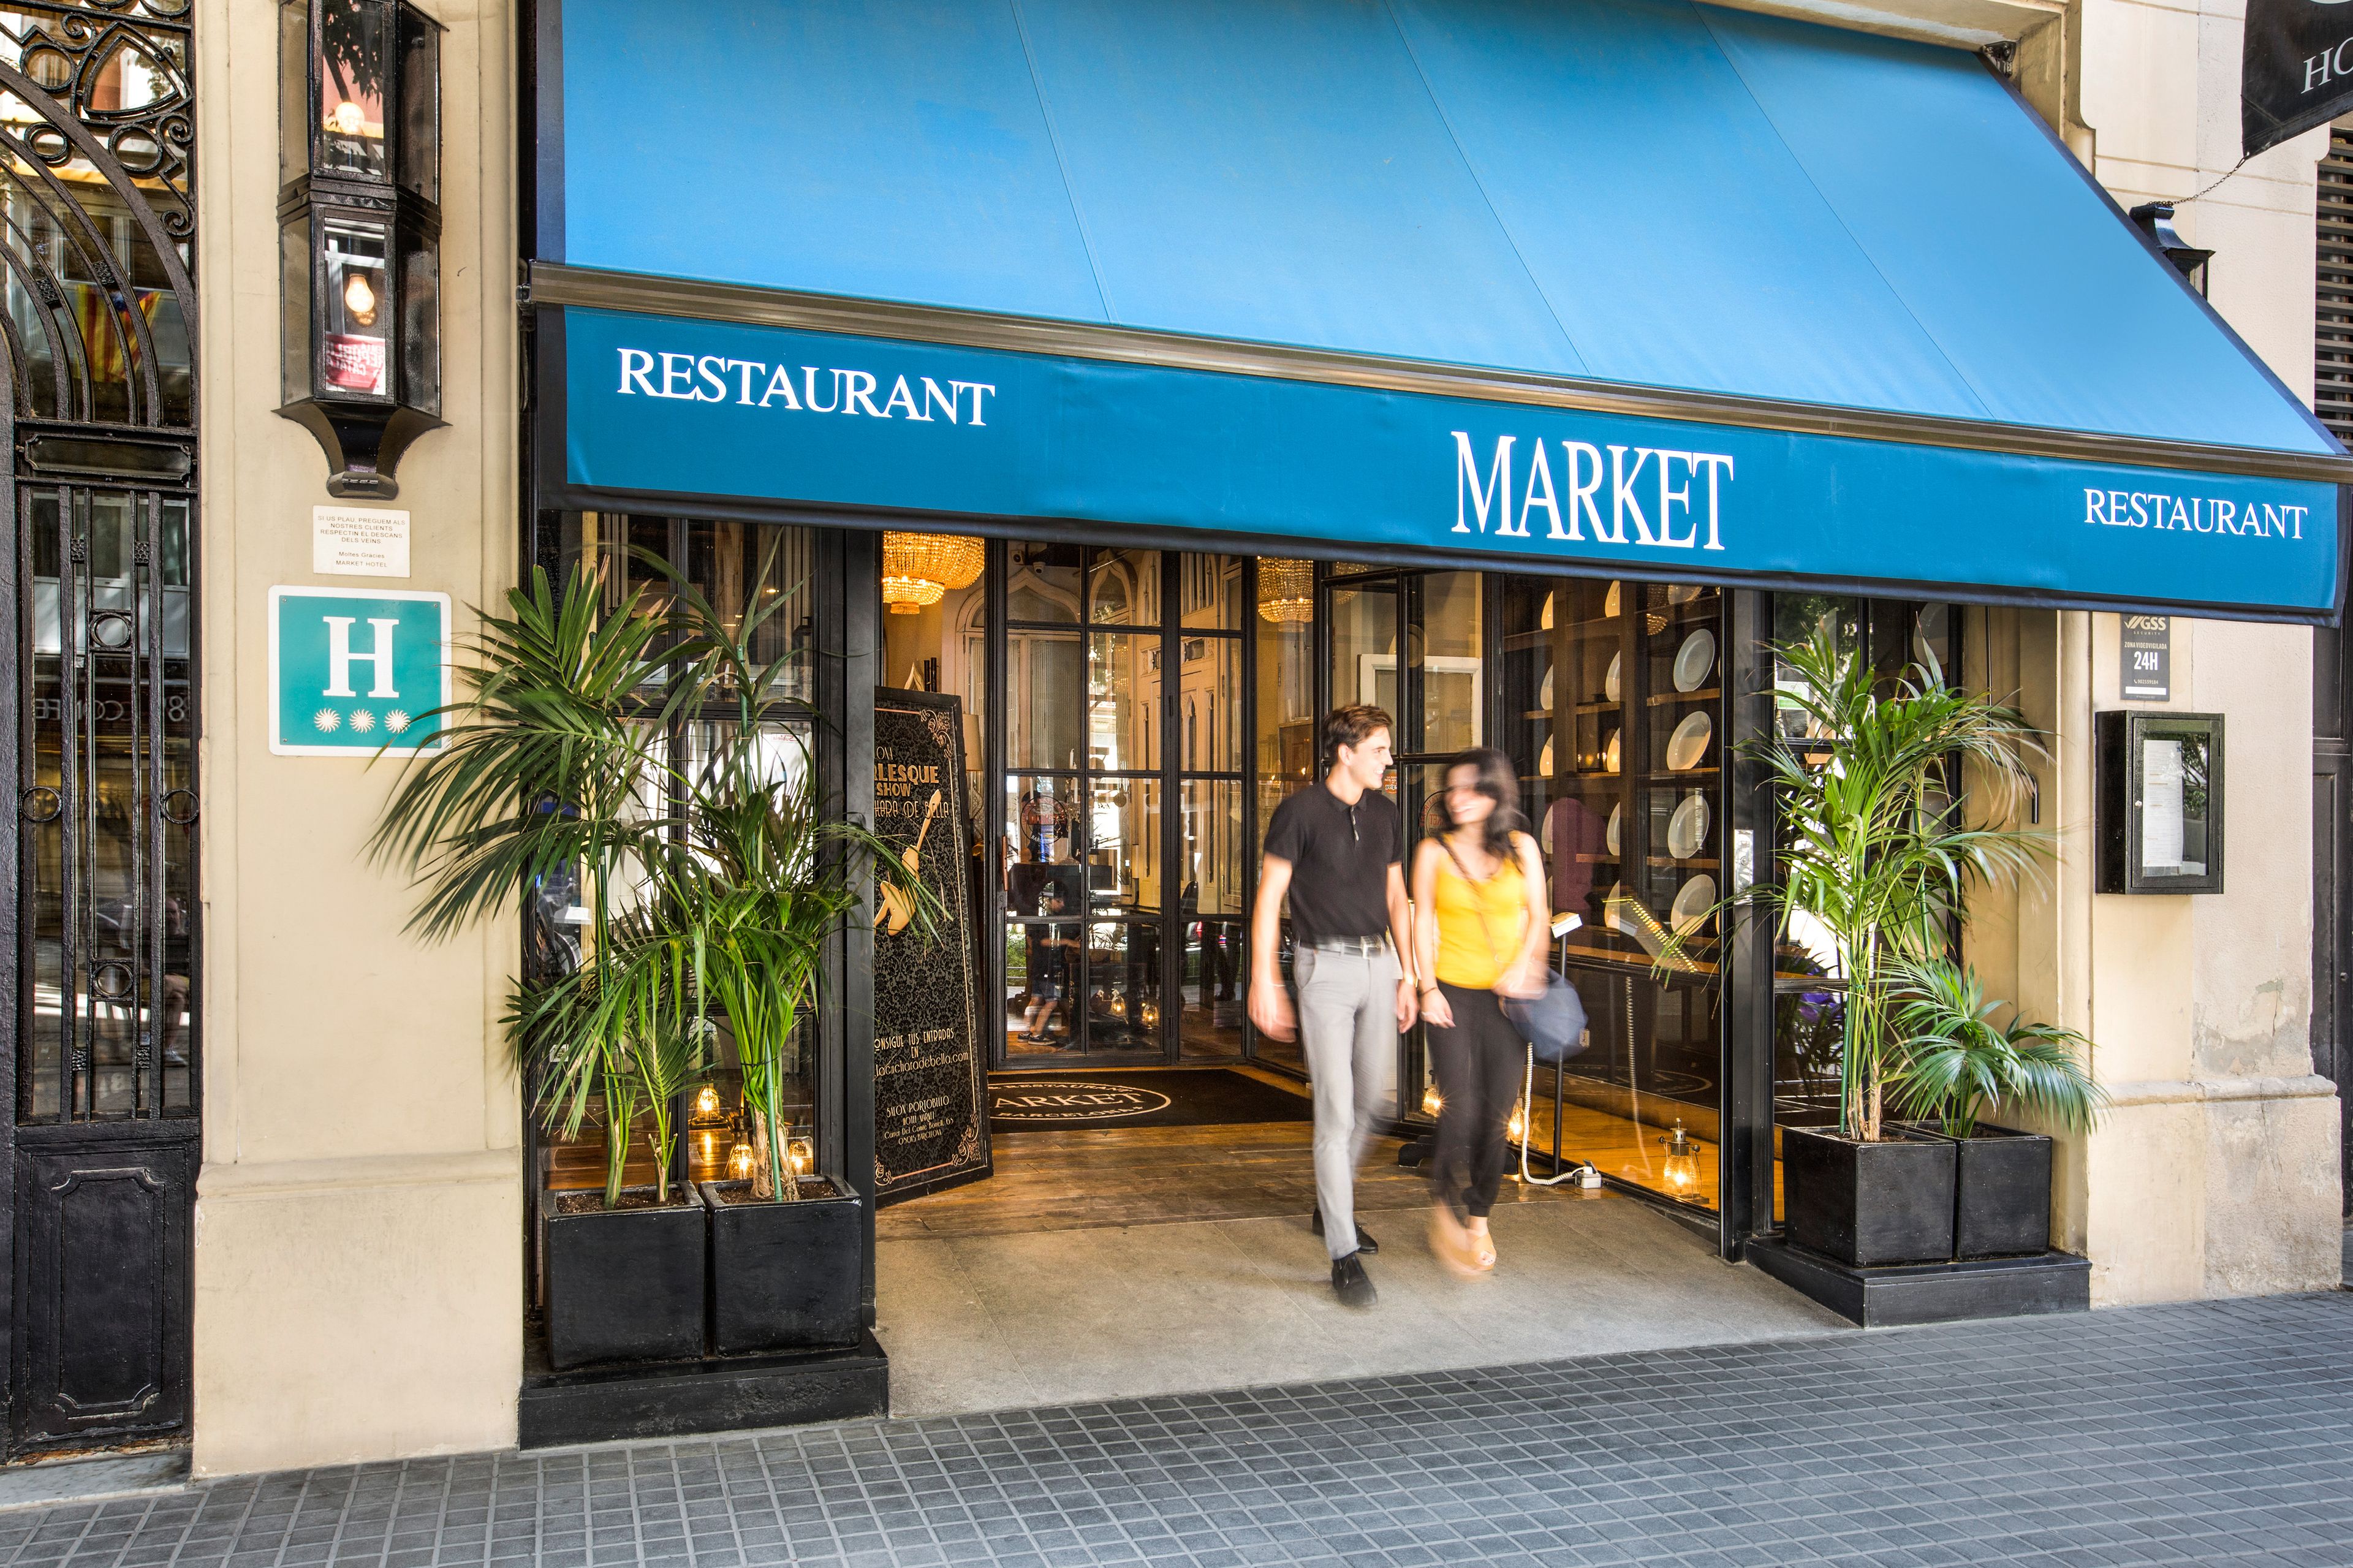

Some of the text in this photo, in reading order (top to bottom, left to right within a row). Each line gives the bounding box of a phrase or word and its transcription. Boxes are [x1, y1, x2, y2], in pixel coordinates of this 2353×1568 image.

[616, 347, 996, 426] RESTAURANT
[1451, 431, 1734, 550] MARKET
[2083, 488, 2308, 539] RESTAURANT
[2140, 616, 2166, 631] GSS
[323, 616, 400, 698] H
[2134, 651, 2158, 670] 24H
[877, 782, 911, 797] SHOW
[903, 801, 919, 818] DE
[925, 801, 949, 819] BELLA
[874, 1028, 954, 1051] ONSIGUE TUS ENTRADAS
[911, 1046, 919, 1059] EN
[990, 1093, 1144, 1108] ARKET
[998, 1108, 1134, 1117] BARCELONA
[902, 1127, 911, 1135] Del
